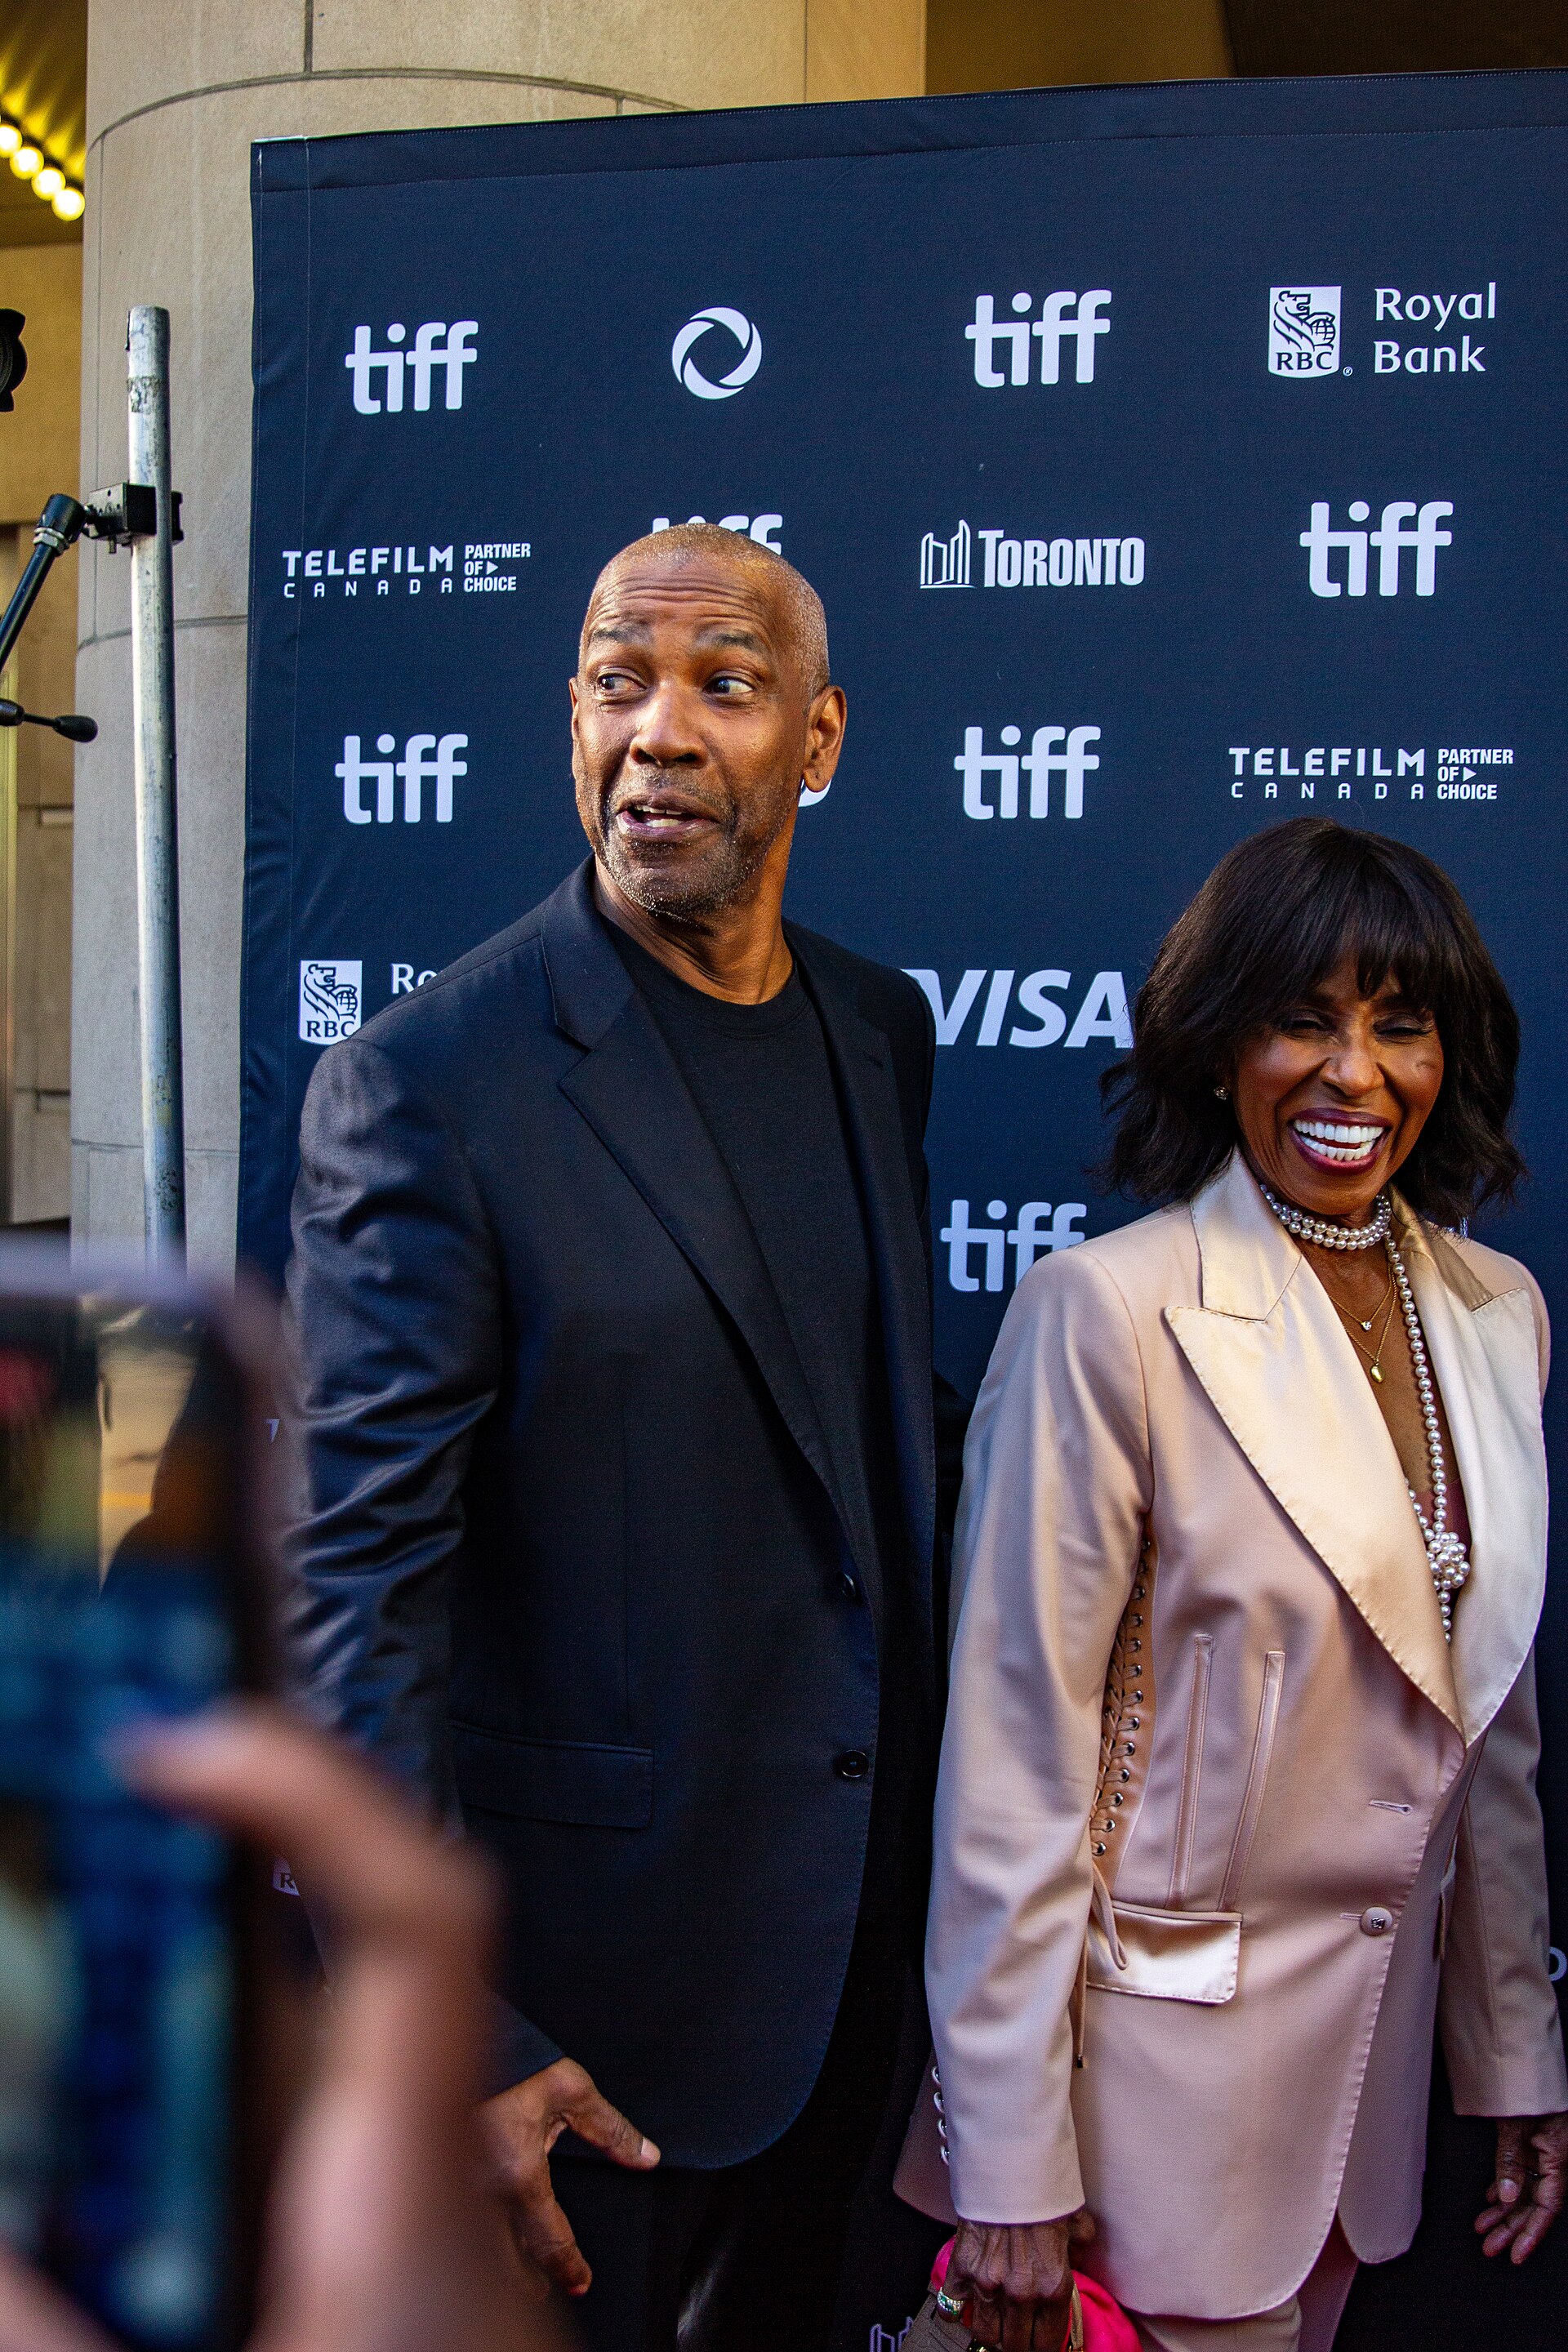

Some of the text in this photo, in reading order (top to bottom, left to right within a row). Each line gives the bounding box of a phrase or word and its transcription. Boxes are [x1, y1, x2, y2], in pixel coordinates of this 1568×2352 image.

[1374, 282, 1496, 332] Royal
[964, 289, 1111, 387] tiff
[345, 320, 479, 415] tiff
[1276, 351, 1333, 370] RBC
[1374, 335, 1486, 374] Bank
[283, 545, 454, 577] TELEFILM
[465, 542, 531, 559] PARTNER
[978, 529, 1145, 587] TORONTO
[1299, 501, 1454, 598] tiff
[464, 560, 483, 575] OF
[283, 577, 452, 599] CANADA
[463, 576, 517, 593] CHOICE
[1228, 747, 1425, 777] TELEFILM
[1437, 748, 1514, 764] PARTNER
[334, 733, 469, 825] tiff
[953, 725, 1102, 820] tiff
[1437, 766, 1459, 782] OF
[1231, 782, 1424, 800] CANADA
[1437, 784, 1498, 800] CHOICE
[900, 969, 1134, 1049] VISA
[306, 1020, 355, 1038] RBC
[940, 1199, 1088, 1292] tiff
